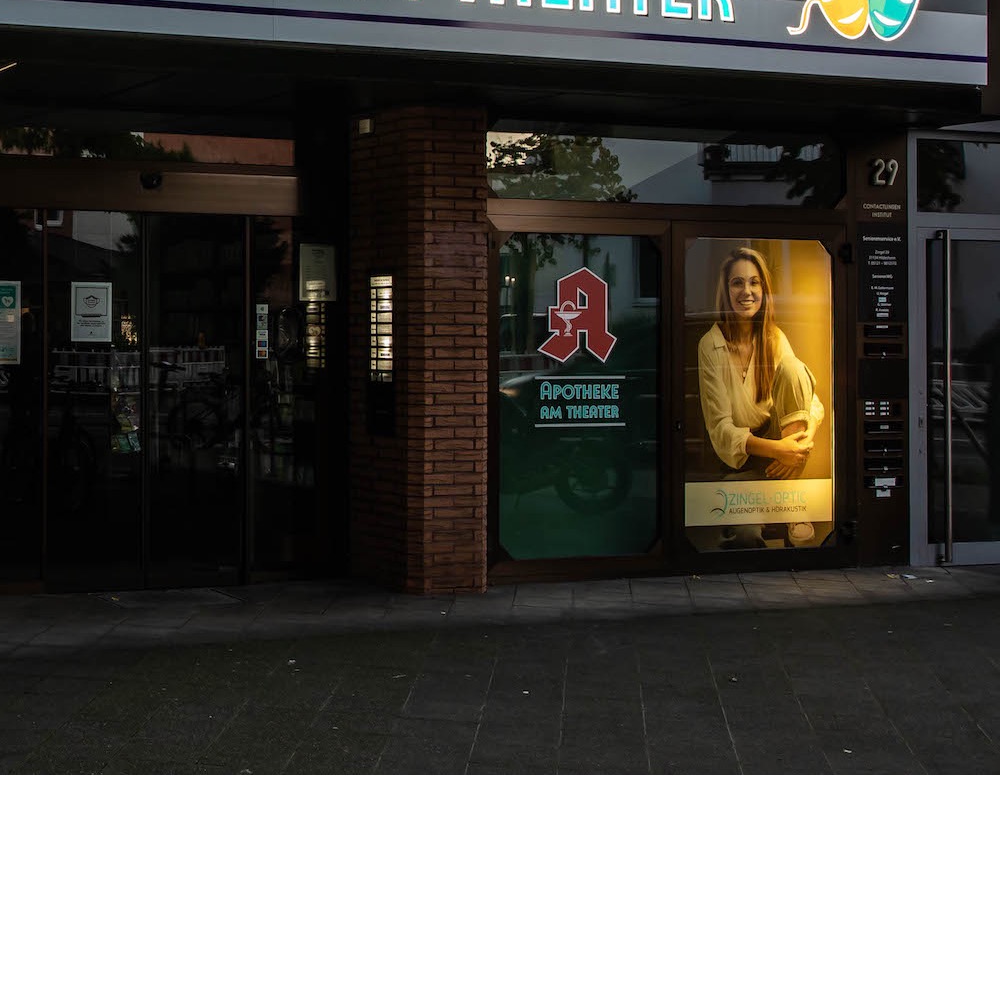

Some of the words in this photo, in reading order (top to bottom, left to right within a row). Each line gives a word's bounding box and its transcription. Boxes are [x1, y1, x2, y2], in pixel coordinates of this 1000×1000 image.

[874, 158, 899, 186] 29
[540, 380, 620, 401] APOTHEKE
[540, 404, 563, 420] AM
[565, 403, 620, 419] THEATER
[728, 507, 765, 515] AUGENOPTIK
